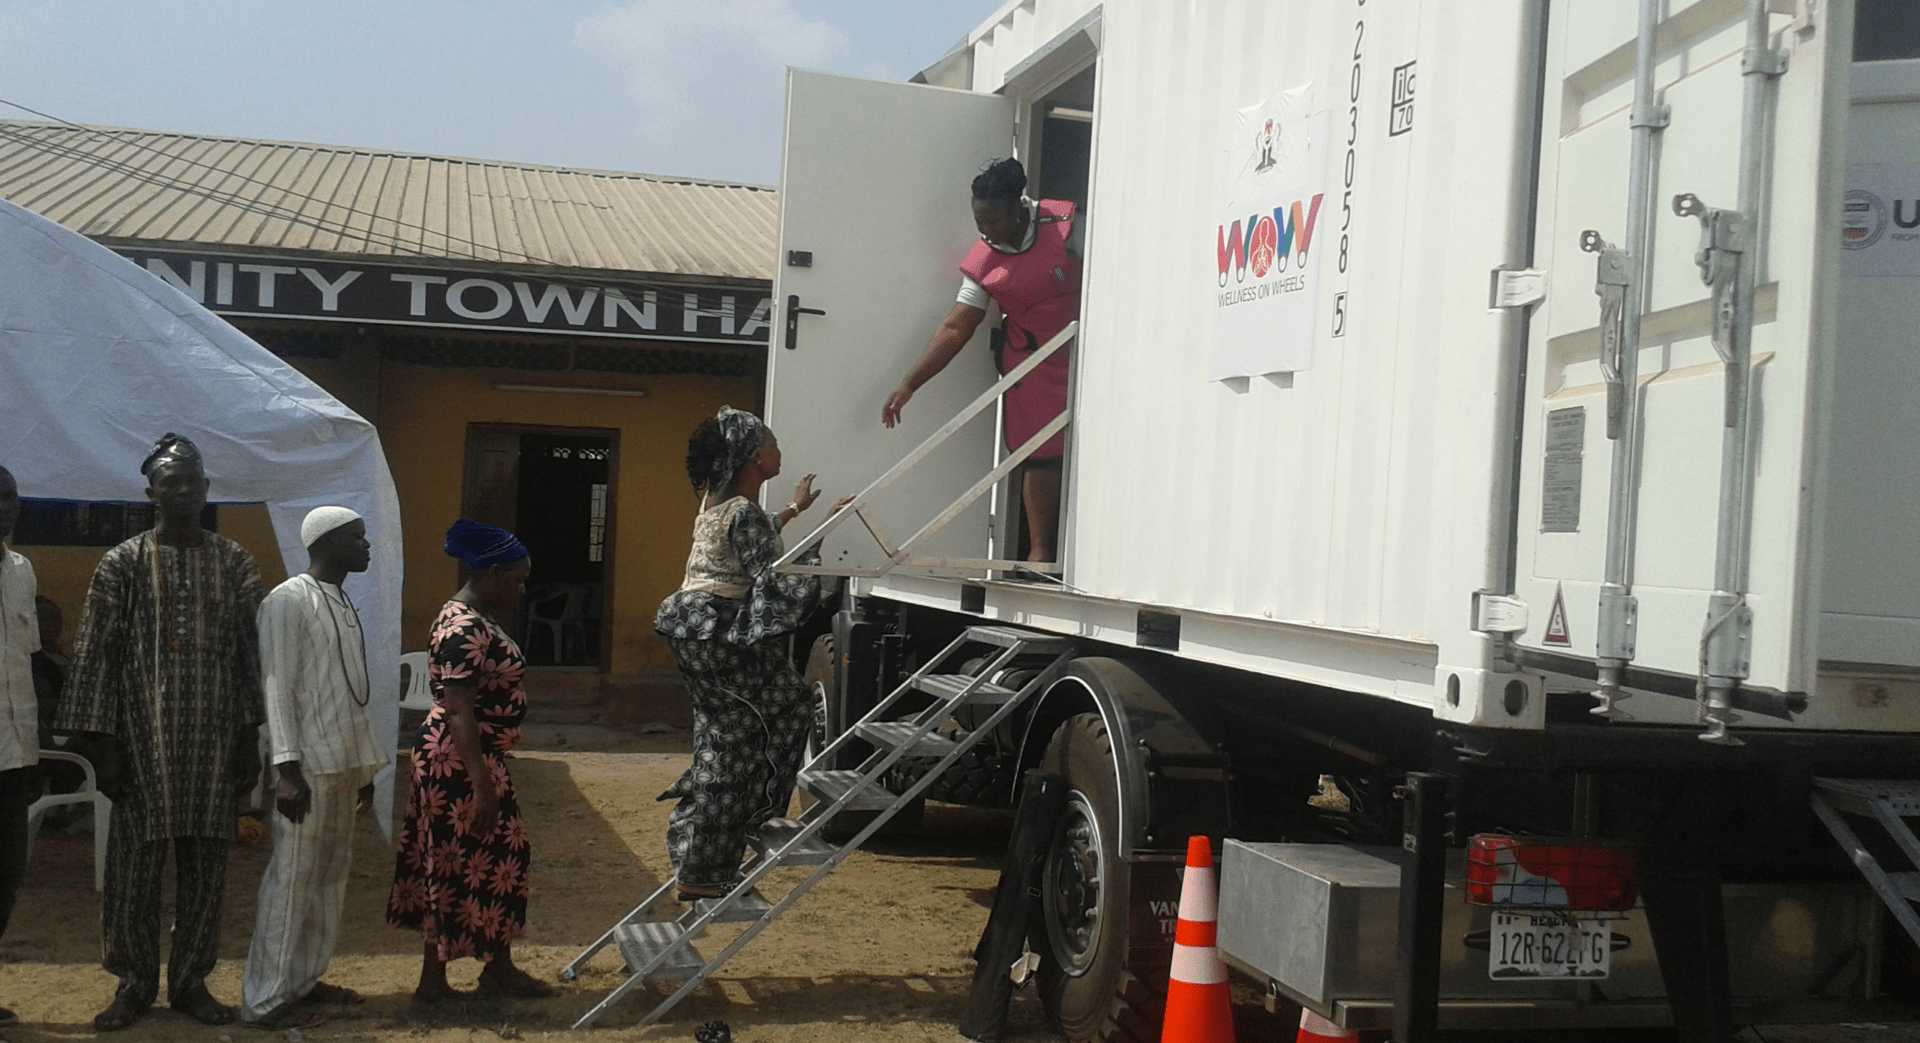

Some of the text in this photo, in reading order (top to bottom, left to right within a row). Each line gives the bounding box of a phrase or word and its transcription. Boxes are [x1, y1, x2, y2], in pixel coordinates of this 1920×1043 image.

[1217, 193, 1324, 288] WOW
[124, 256, 364, 312] NITY
[390, 273, 657, 331] TOWN
[1218, 275, 1305, 308] WELLNESS ON WHEELS
